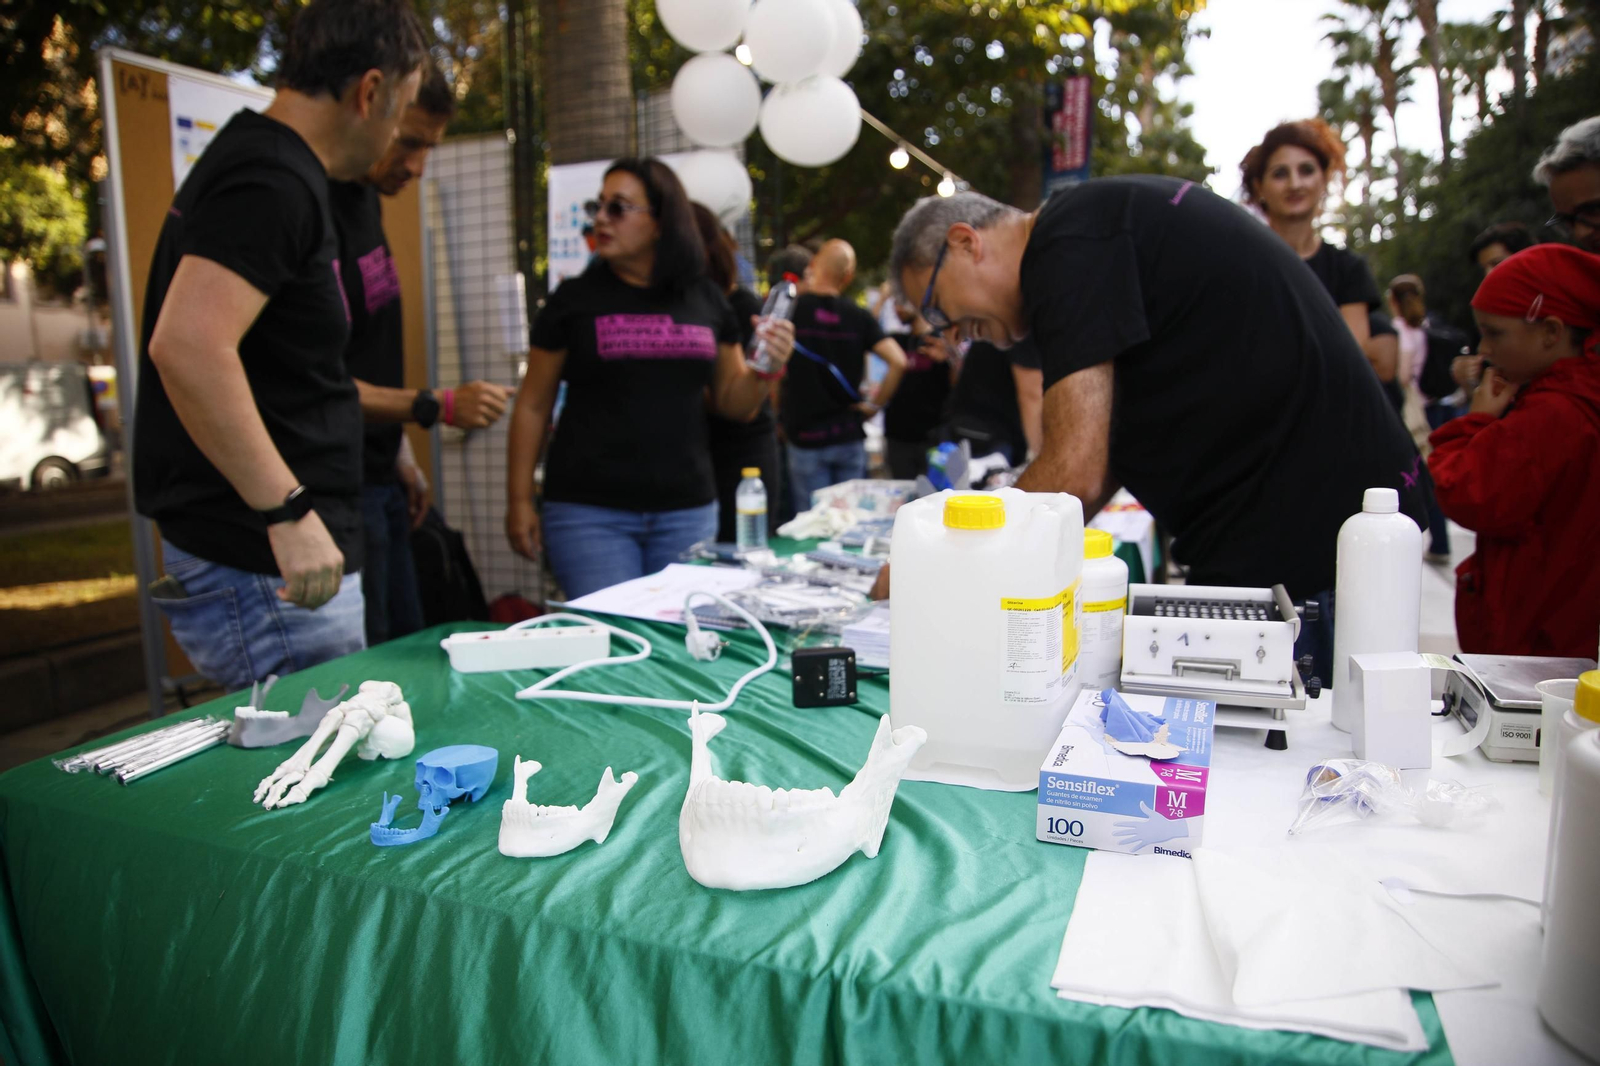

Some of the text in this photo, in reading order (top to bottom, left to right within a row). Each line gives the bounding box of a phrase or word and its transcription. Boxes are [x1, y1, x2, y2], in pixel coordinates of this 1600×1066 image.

[1052, 745, 1075, 768] Bimedica
[1175, 768, 1202, 783] M
[1046, 790, 1070, 798] Guantes
[1047, 776, 1116, 797] Sensiflex
[1054, 798, 1072, 806] nitrilo
[1081, 802, 1098, 810] polvo
[1166, 790, 1188, 809] M
[1169, 808, 1184, 818] 7-8
[1047, 816, 1084, 837] 100
[1046, 834, 1067, 842] Unidades
